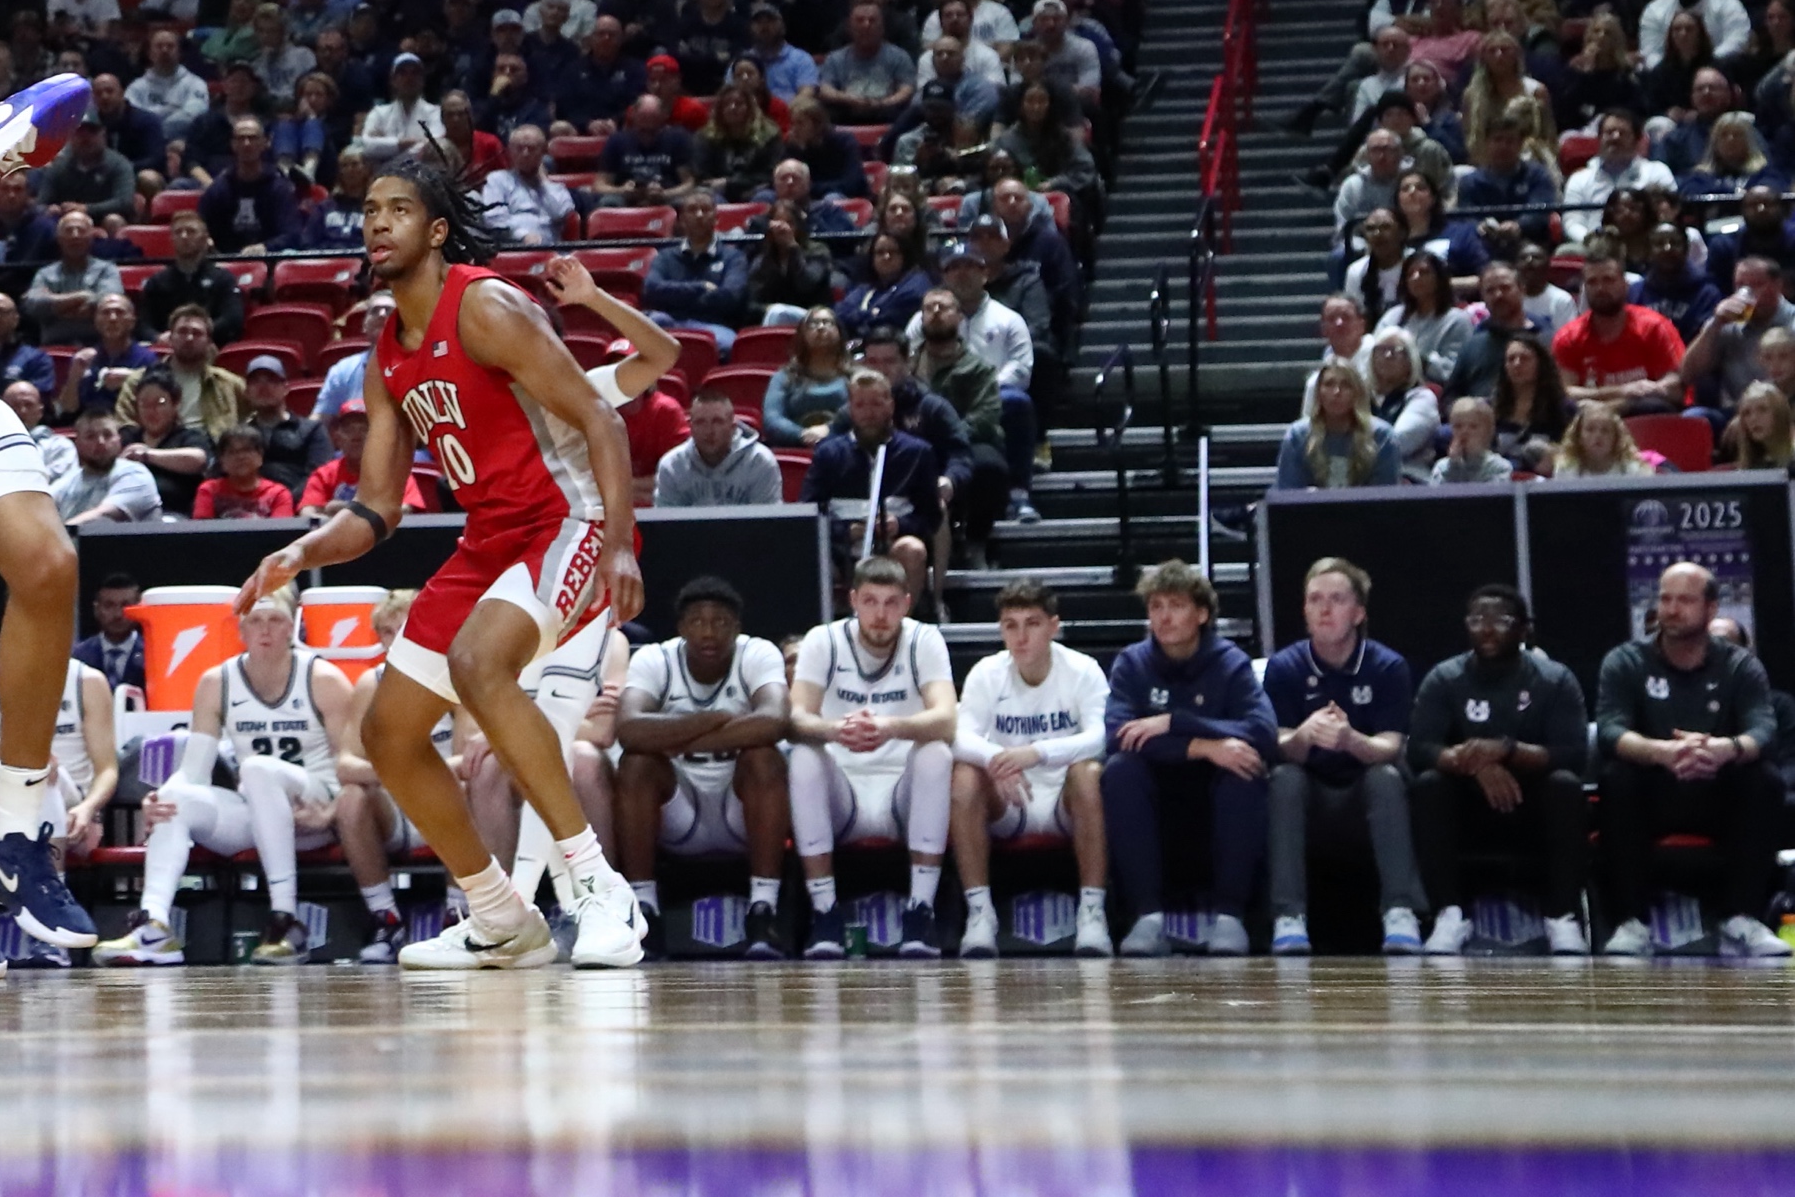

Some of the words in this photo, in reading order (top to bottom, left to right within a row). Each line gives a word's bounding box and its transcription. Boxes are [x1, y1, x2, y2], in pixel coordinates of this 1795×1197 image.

[401, 379, 467, 446] UNLV
[435, 433, 477, 491] 10
[1680, 501, 1743, 530] 2025
[836, 687, 868, 704] UTAH
[235, 721, 267, 733] UTAH
[272, 720, 309, 732] STATE
[995, 714, 1048, 735] NOTHING
